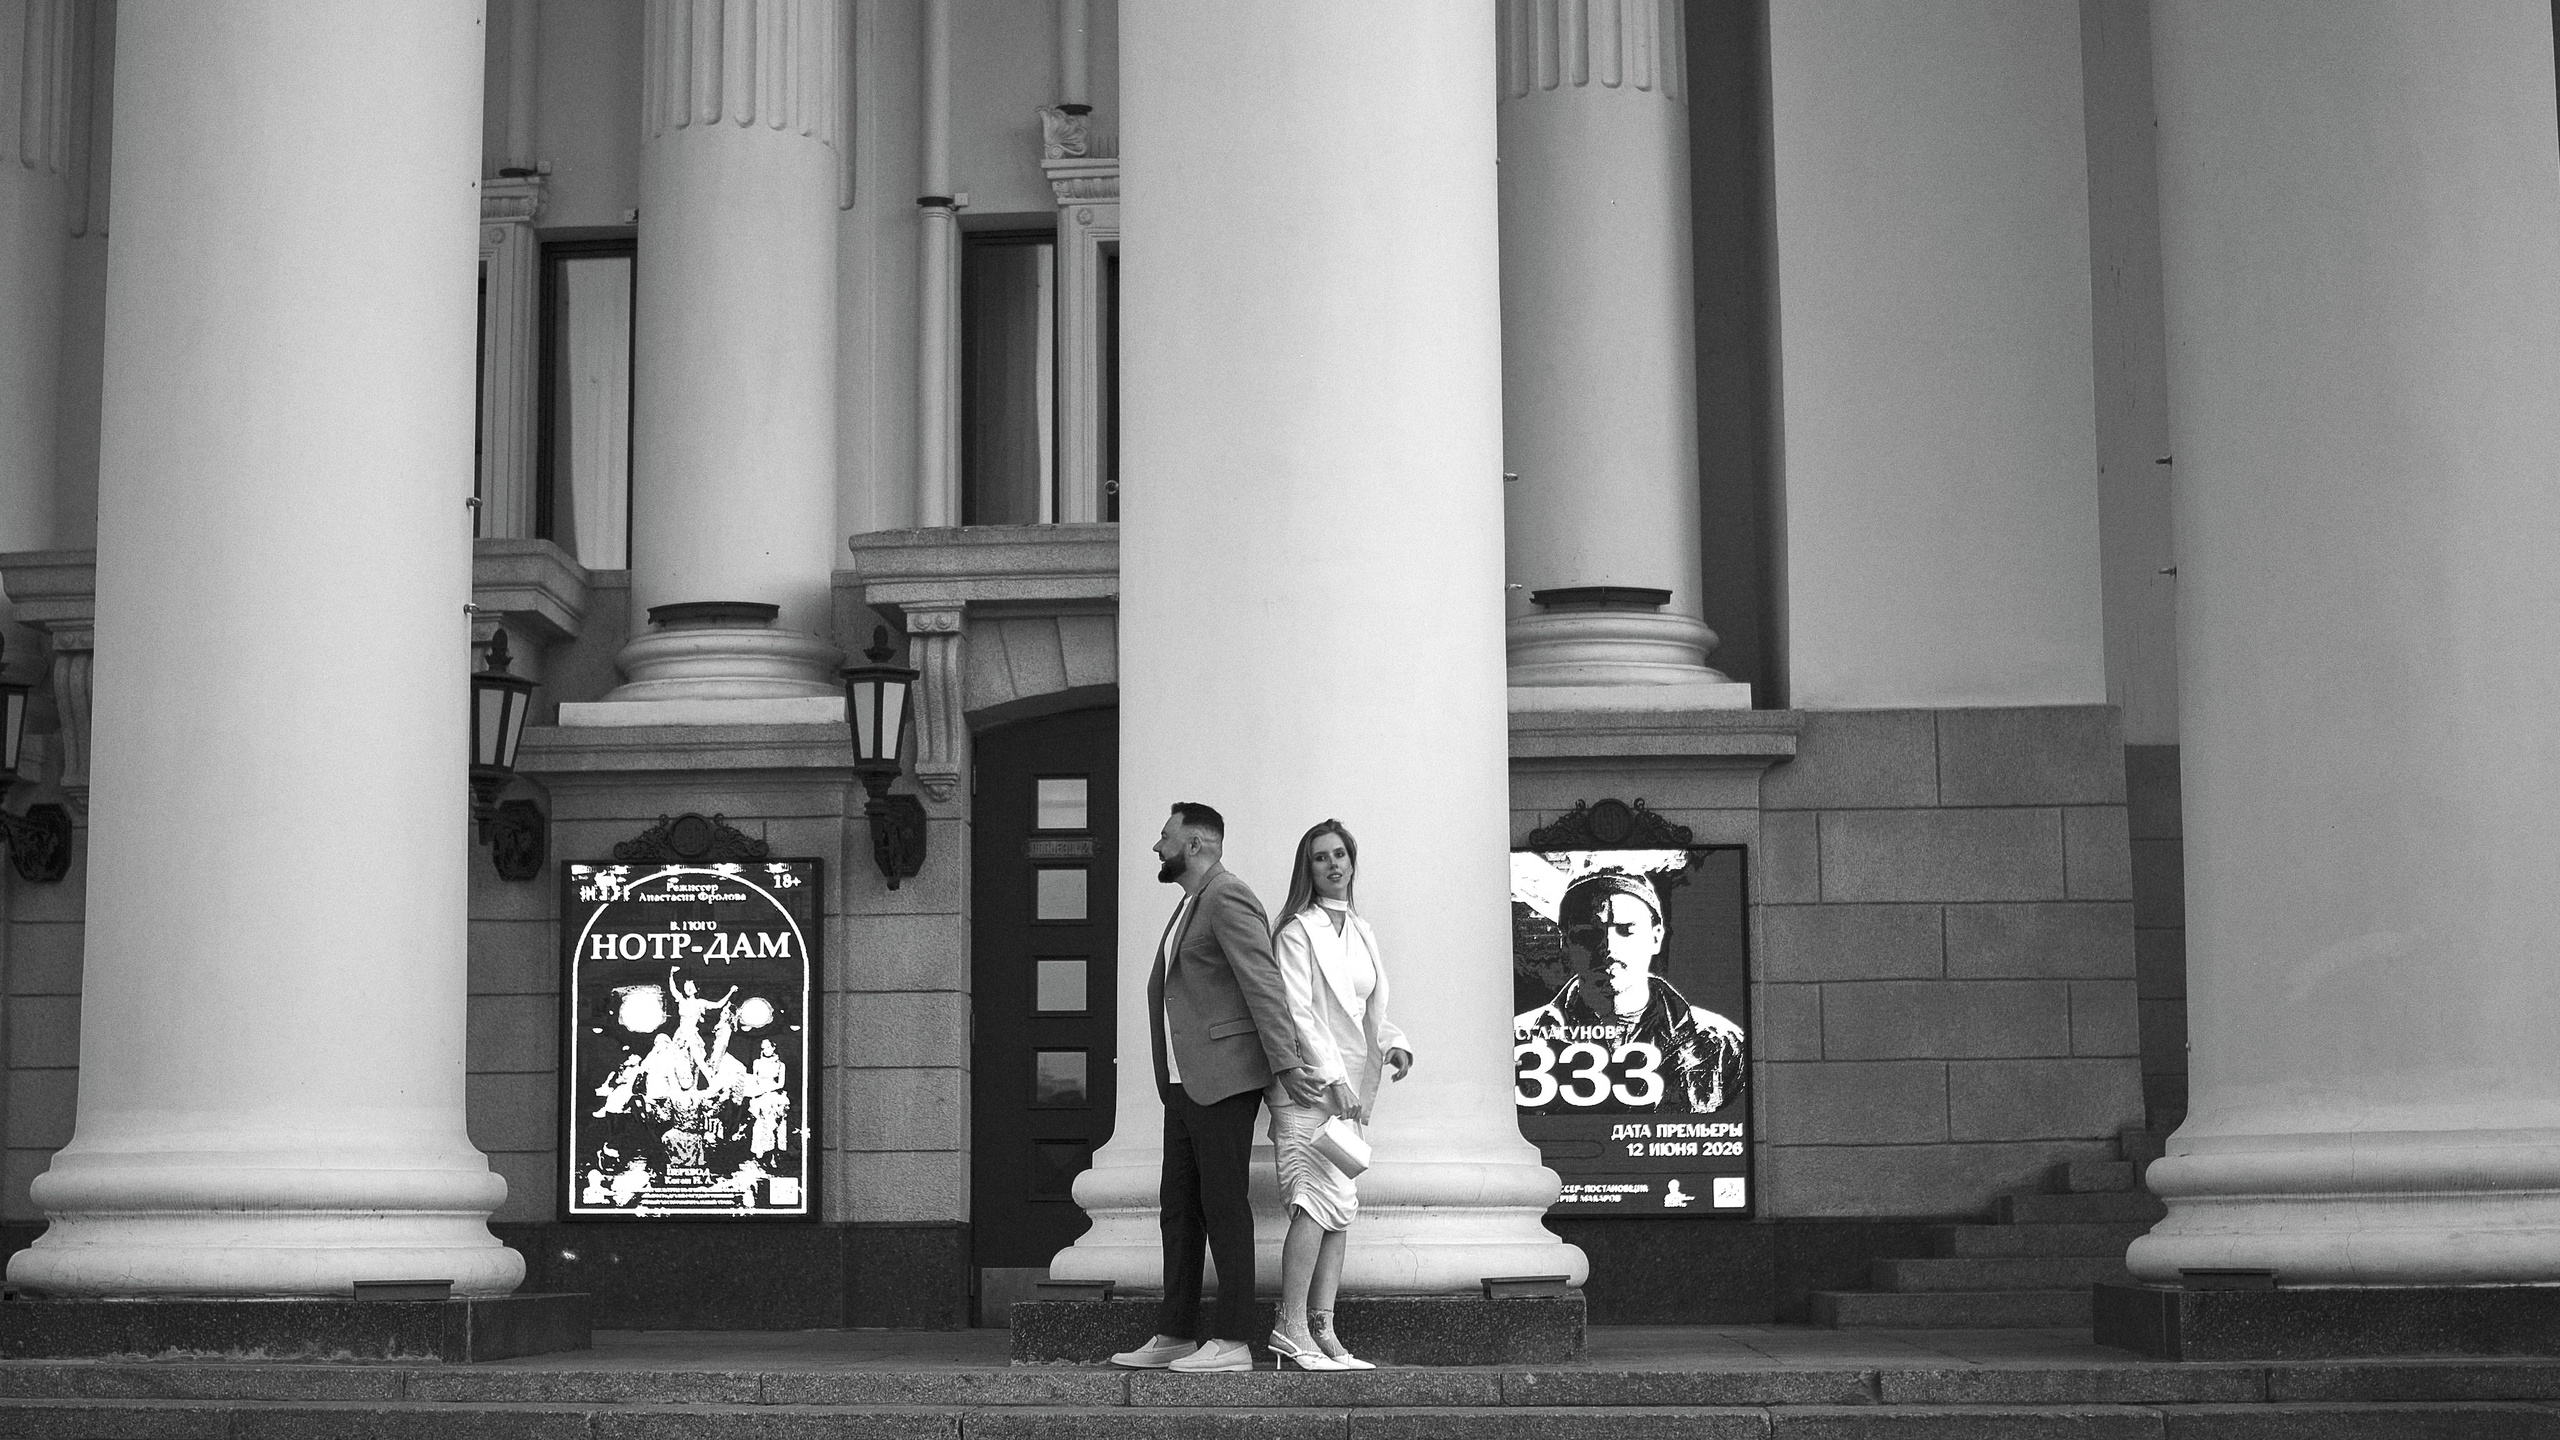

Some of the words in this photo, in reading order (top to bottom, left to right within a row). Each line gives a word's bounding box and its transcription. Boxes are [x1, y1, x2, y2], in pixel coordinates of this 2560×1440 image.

[666, 882, 719, 895] Режиссер
[773, 874, 802, 889] 18+
[590, 931, 792, 965] НОТР-ДАМ
[1514, 1042, 1665, 1107] 333
[1610, 1123, 1652, 1141] ДАТА
[1656, 1122, 1744, 1138] ПРЕМЬЕРЫ
[1625, 1142, 1645, 1157] 12
[1648, 1142, 1698, 1157] ИЮНЯ
[1702, 1141, 1744, 1156] 2026
